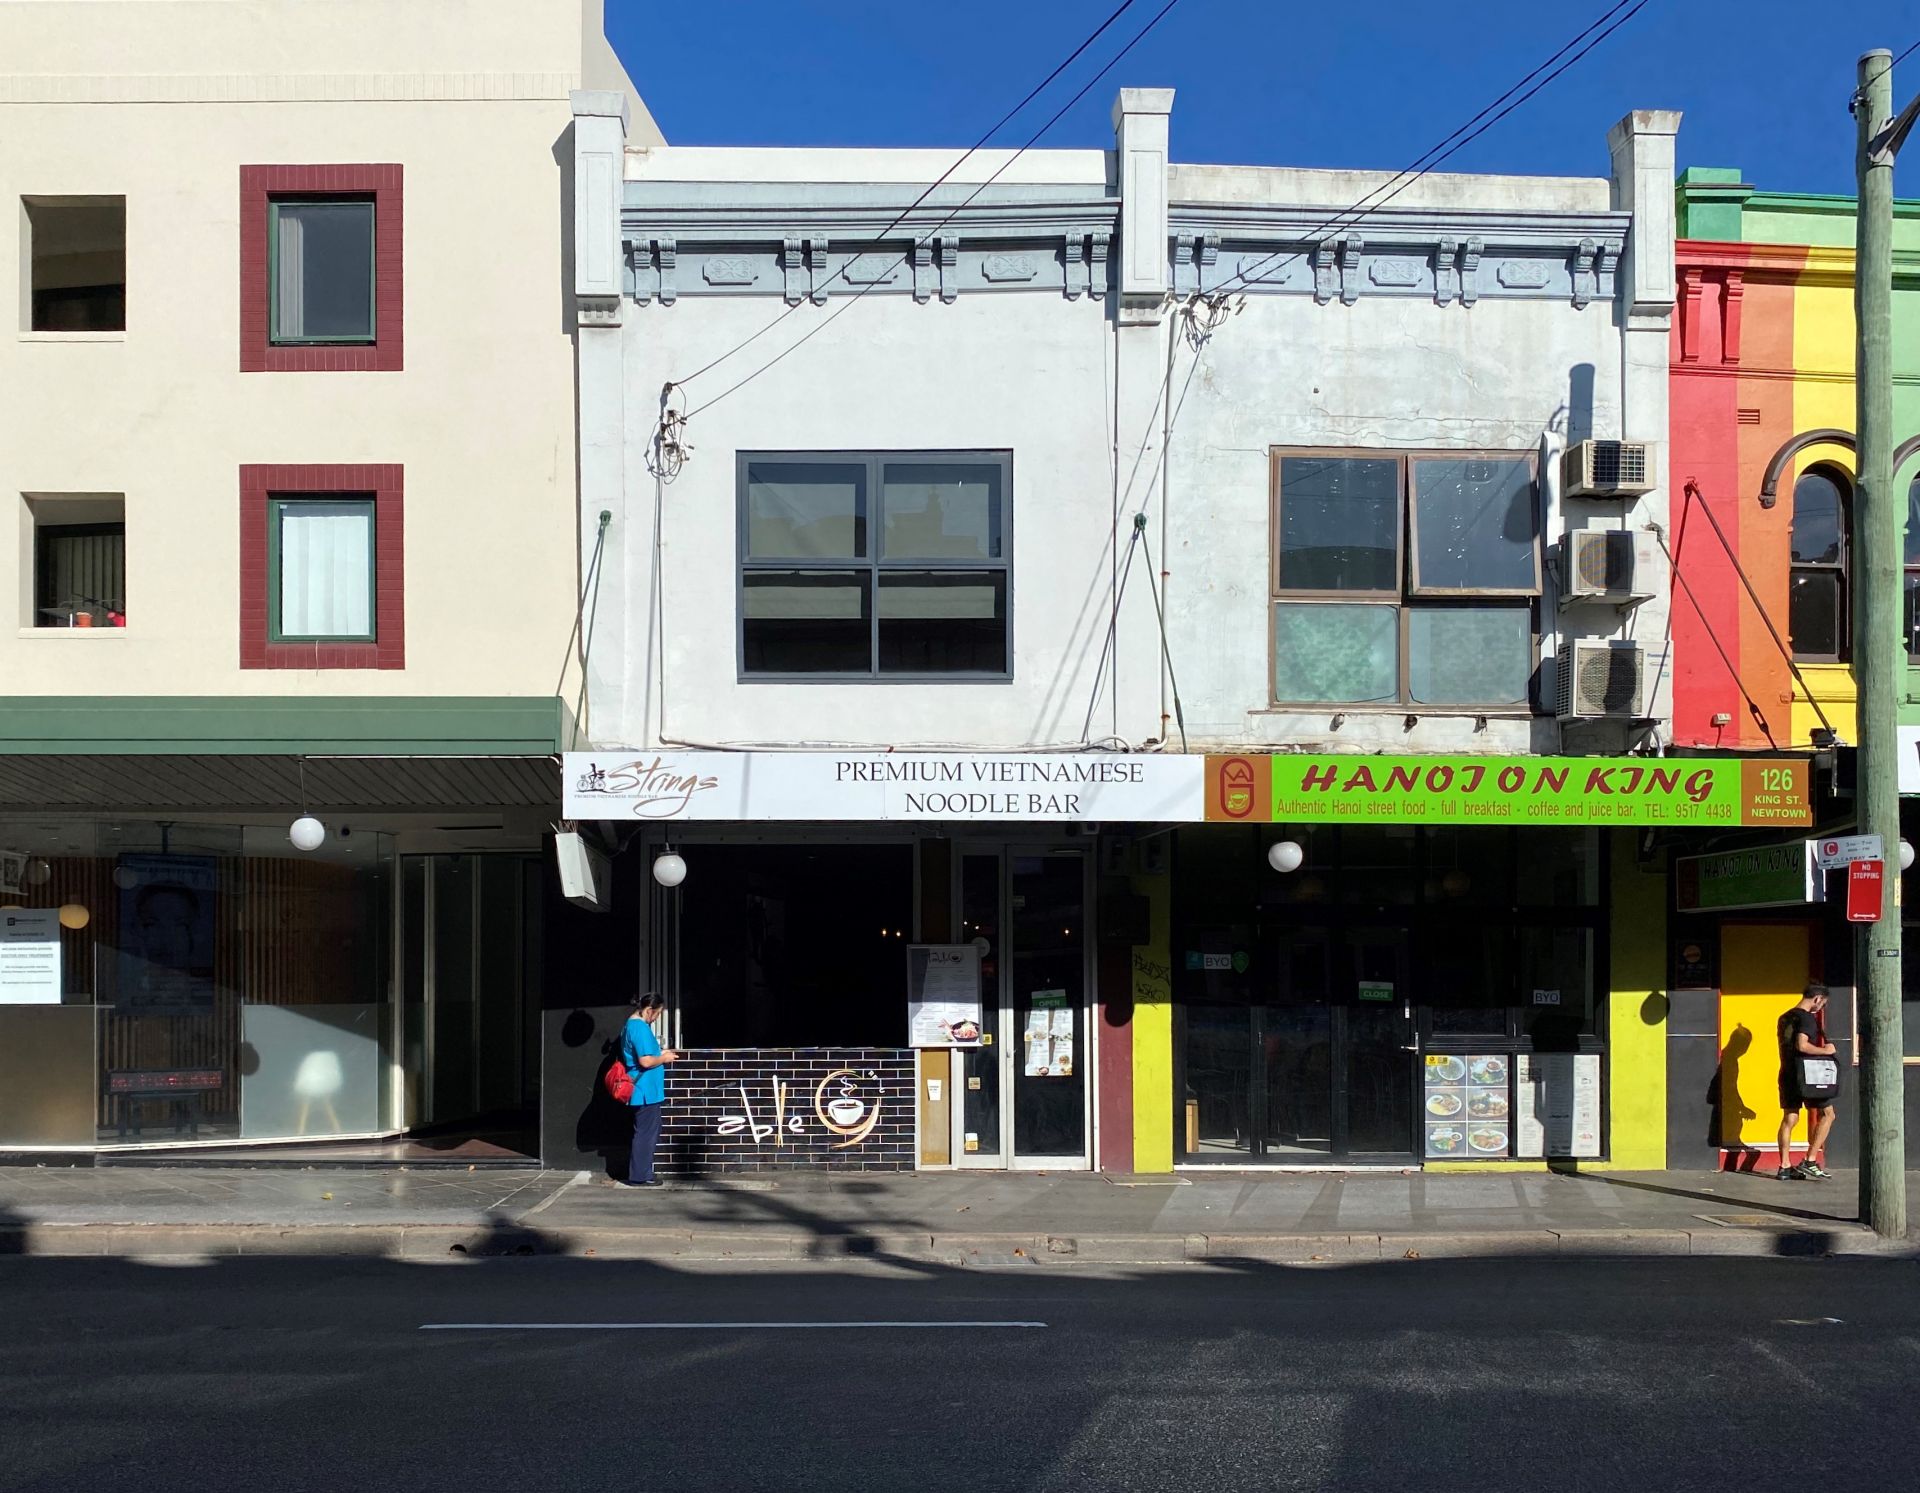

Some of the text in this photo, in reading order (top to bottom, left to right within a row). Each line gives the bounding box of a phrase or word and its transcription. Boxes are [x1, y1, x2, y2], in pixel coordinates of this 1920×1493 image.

[835, 761, 1144, 783] PREMIUM VIETNAMESE
[1760, 768, 1793, 791] 126
[607, 756, 719, 818] Strings
[1300, 764, 1714, 803] HANOI ON KING
[905, 792, 1081, 814] NOODLE BAR
[1754, 795, 1802, 805] KING ST.
[1277, 798, 1326, 815] Authentic
[1332, 799, 1362, 815] Hanoi
[1367, 799, 1396, 815] street
[1402, 800, 1426, 816] food
[1441, 800, 1456, 816] full
[1464, 800, 1511, 817] breakfast
[1527, 801, 1559, 817] coffee
[1565, 802, 1583, 817] and
[1588, 802, 1612, 820] juice
[1617, 802, 1637, 817] bar.
[1644, 804, 1669, 818] TEL:
[1675, 804, 1699, 818] 9517
[1705, 804, 1732, 818] 4438
[1751, 808, 1806, 818] NEWTOWN
[1826, 843, 1836, 855] C
[1747, 853, 1761, 874] ON
[1767, 847, 1800, 873] KING
[1205, 957, 1229, 967] BYO
[1363, 990, 1389, 998] CLOSE
[1535, 992, 1559, 1002] BYO
[1039, 999, 1061, 1007] OPEN
